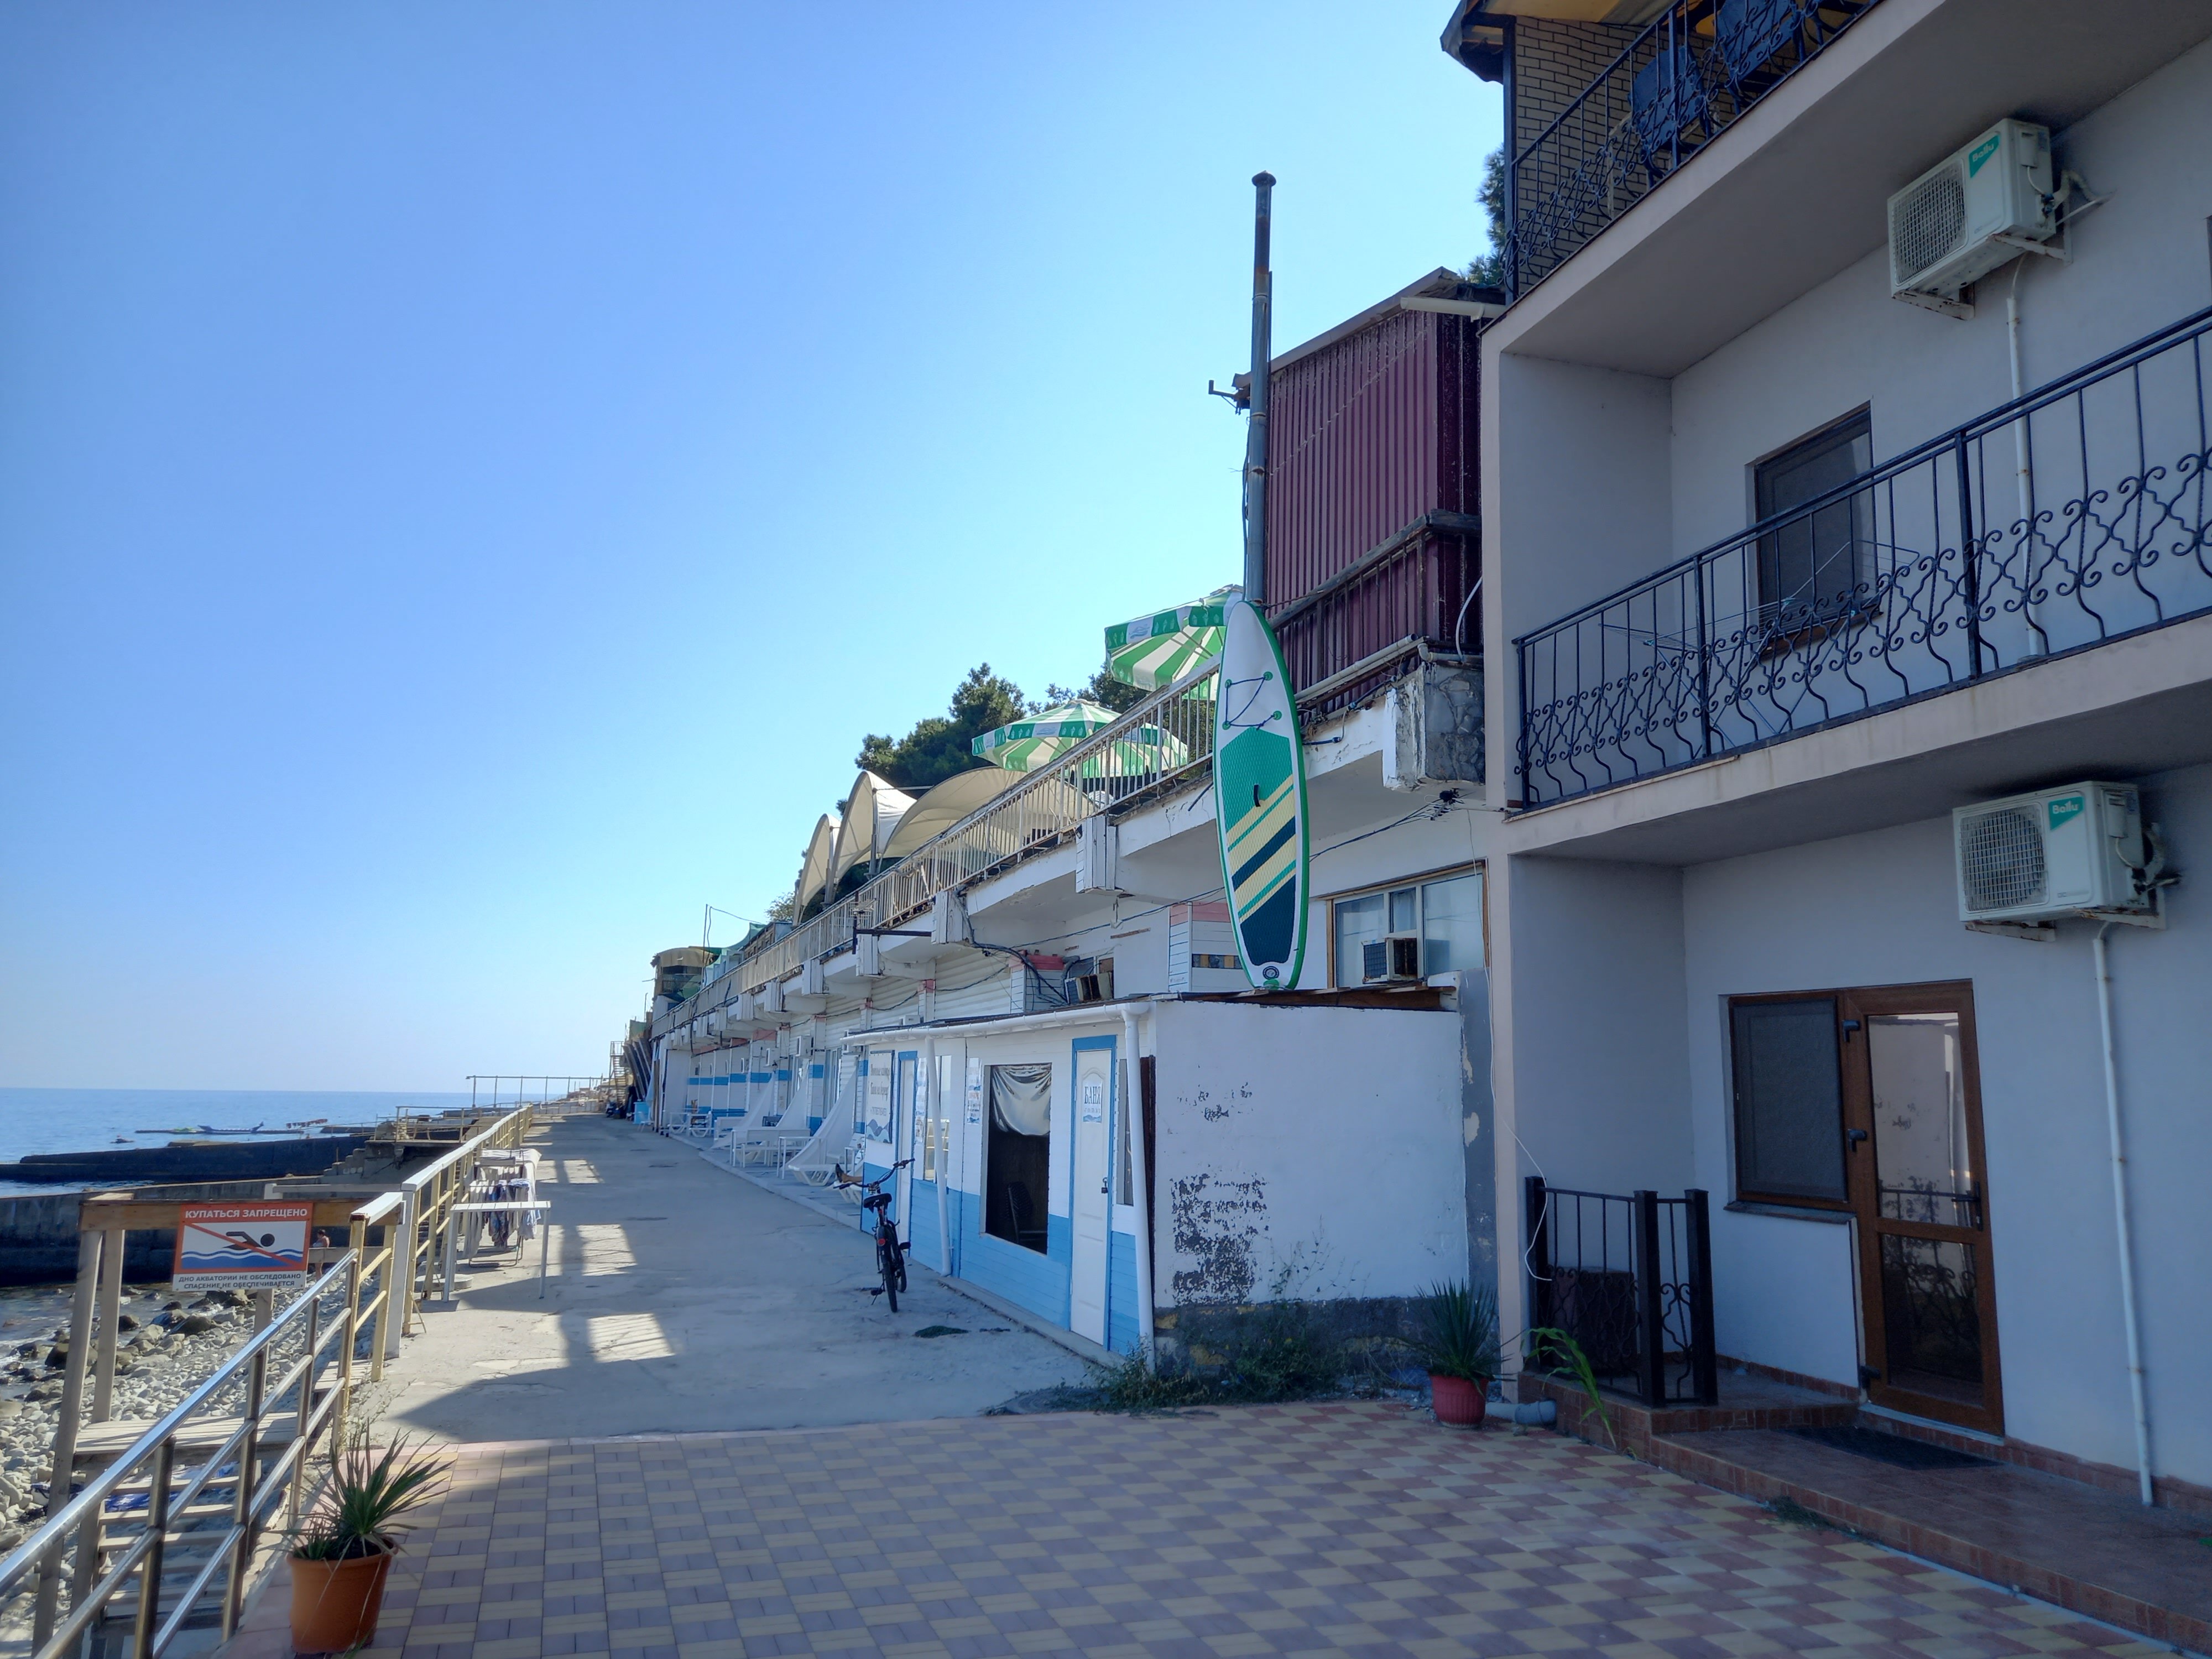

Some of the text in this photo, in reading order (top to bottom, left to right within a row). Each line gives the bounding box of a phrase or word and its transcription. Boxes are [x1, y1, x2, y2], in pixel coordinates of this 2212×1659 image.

[1972, 143, 1994, 162] Ballu
[2052, 800, 2079, 815] Ballu
[1084, 1086, 1101, 1104] БАНЯ
[185, 1208, 307, 1218] КУПАТЬСЯ ЗАПРЕЩЕНО
